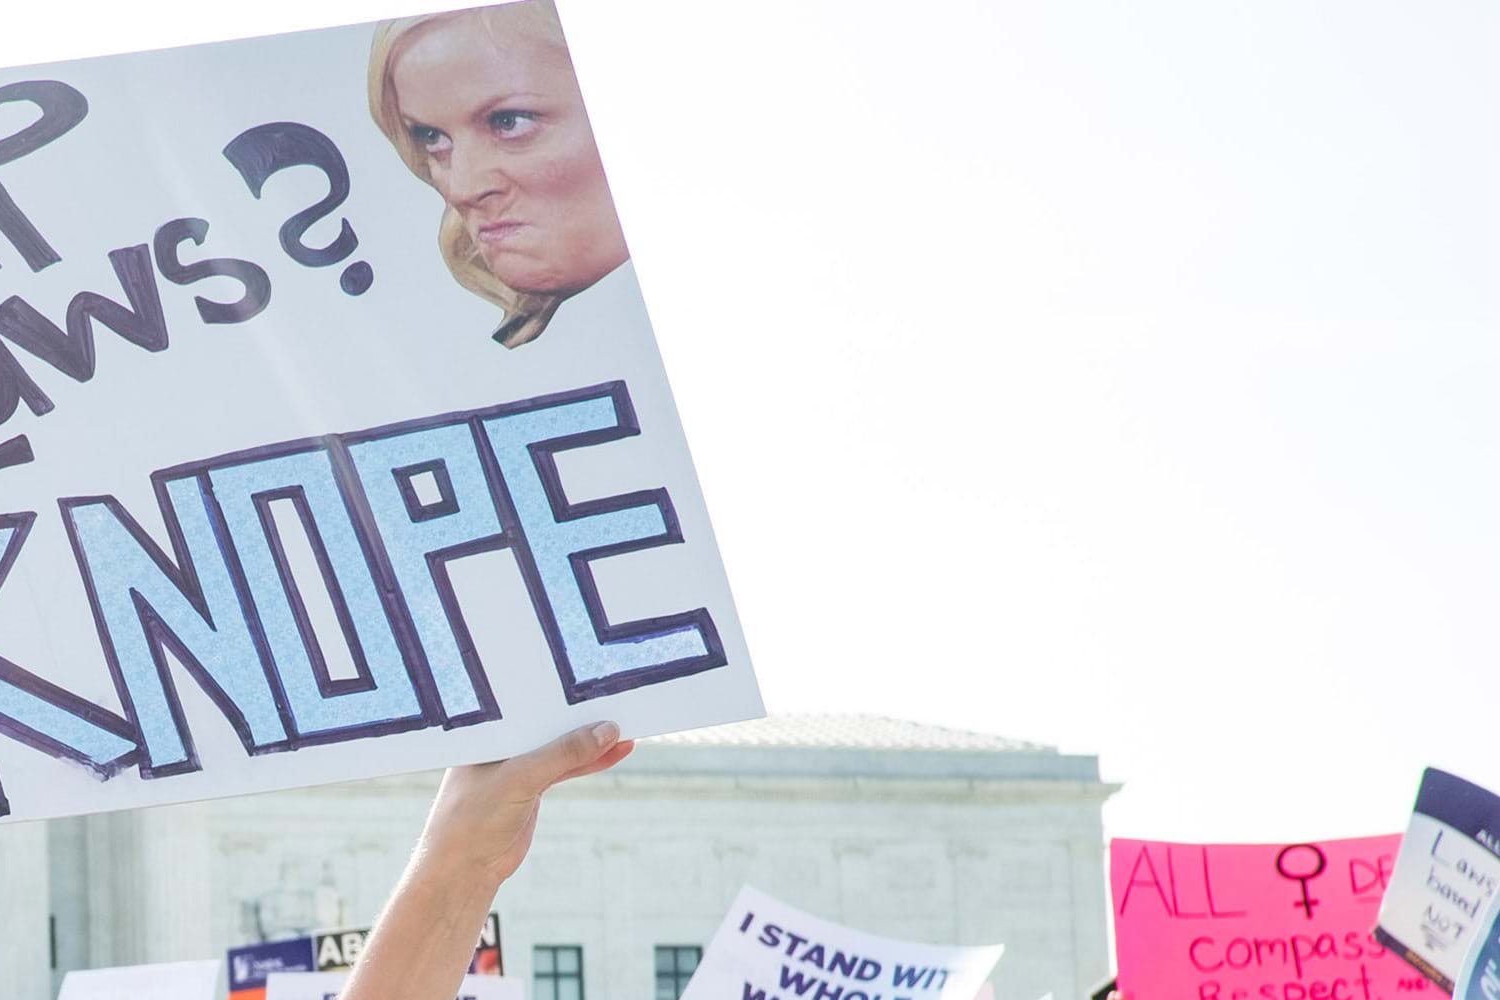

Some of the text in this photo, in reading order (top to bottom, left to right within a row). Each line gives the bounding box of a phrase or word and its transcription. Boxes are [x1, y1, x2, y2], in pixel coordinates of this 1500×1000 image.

[1119, 845, 1247, 919] ALL
[739, 911, 755, 933] I
[758, 924, 882, 982] STAND
